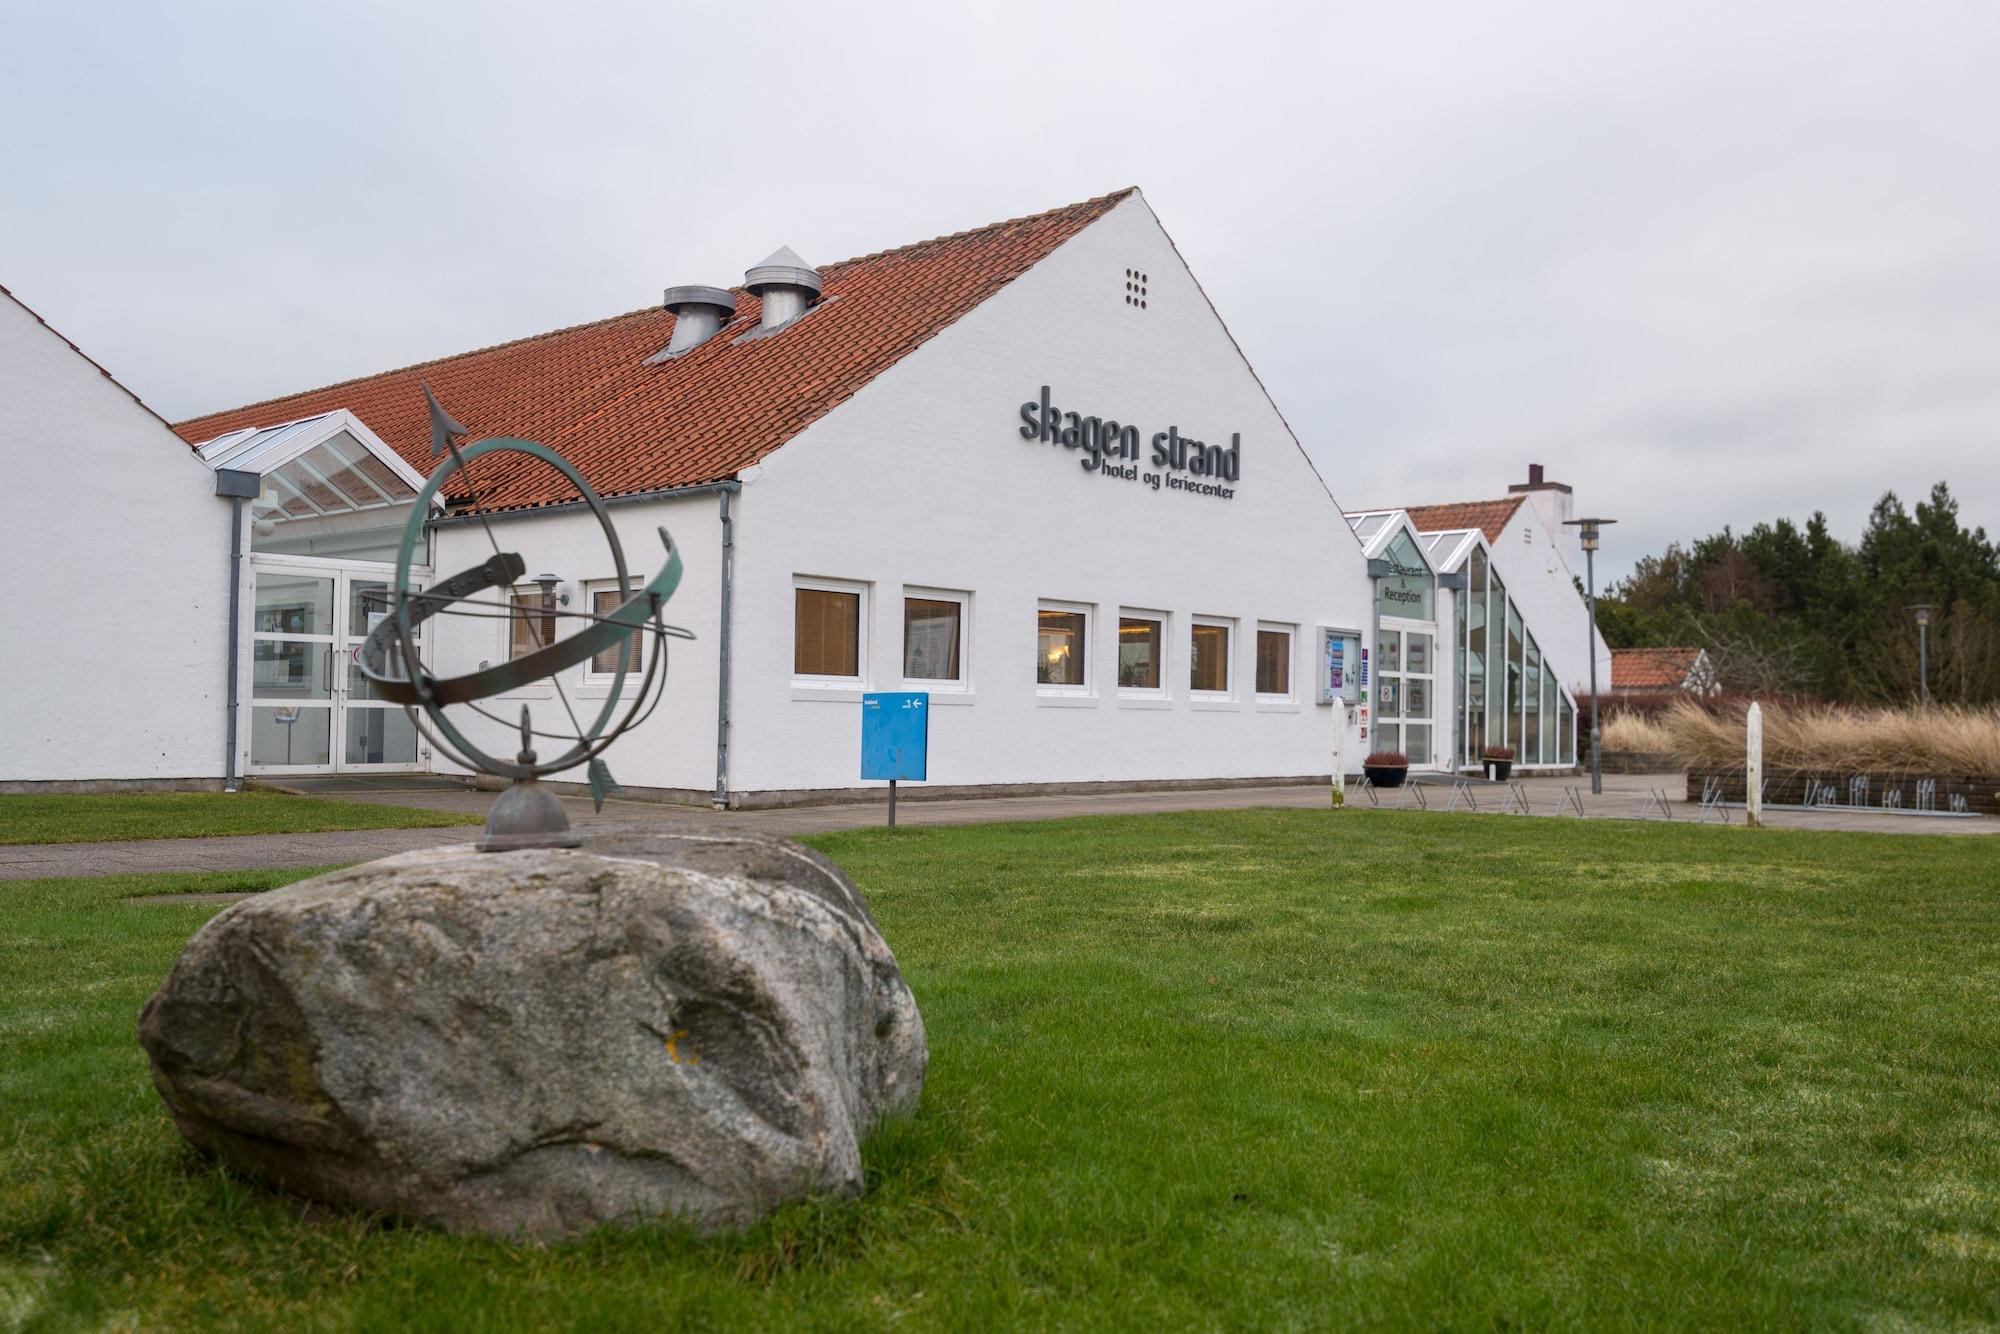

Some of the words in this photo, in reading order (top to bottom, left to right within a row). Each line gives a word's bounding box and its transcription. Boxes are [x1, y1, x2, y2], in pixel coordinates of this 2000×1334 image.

[1019, 385, 1140, 471] skagen
[1151, 425, 1240, 482] strand
[1101, 458, 1138, 481] hotel
[1143, 472, 1161, 491] og
[1165, 472, 1236, 499] feriecenter
[1388, 563, 1423, 577] estaurant
[1384, 586, 1422, 605] Reception
